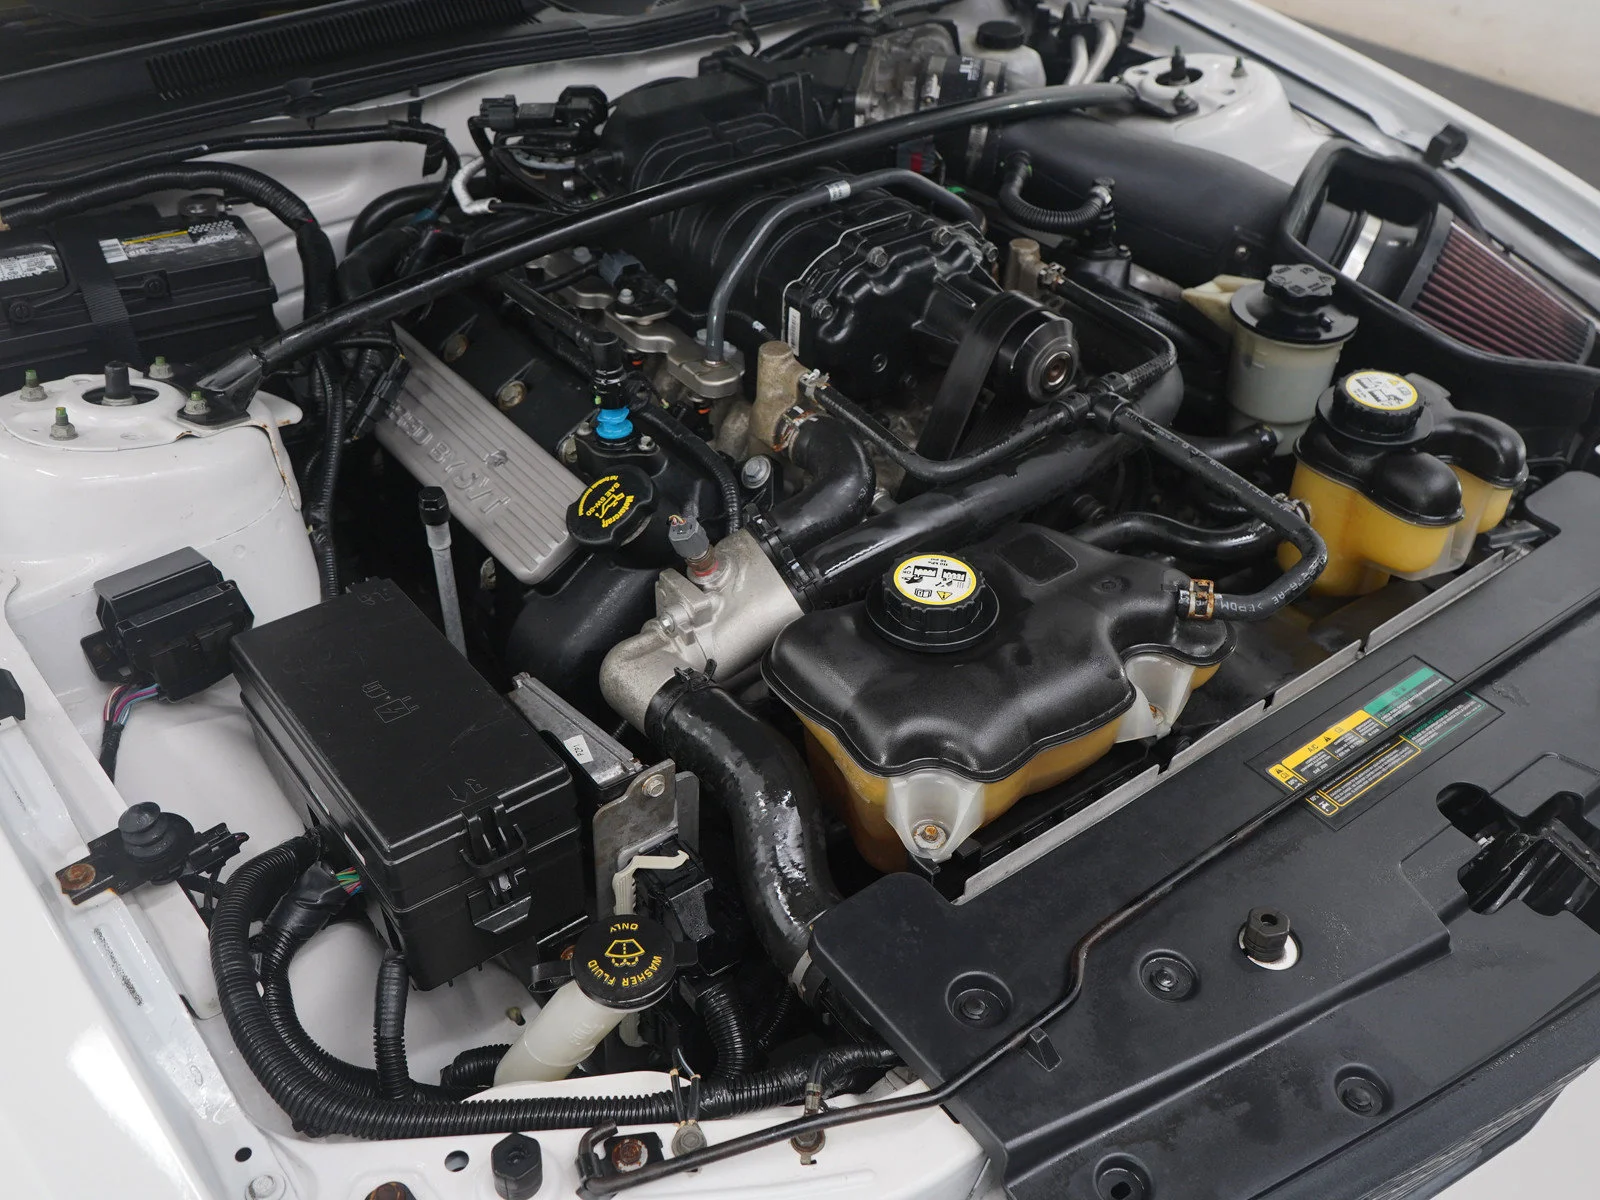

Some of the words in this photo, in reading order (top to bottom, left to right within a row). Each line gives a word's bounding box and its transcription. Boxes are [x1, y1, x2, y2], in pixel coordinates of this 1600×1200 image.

[604, 482, 621, 498] SAE
[585, 496, 607, 517] 5W-50
[602, 495, 635, 528] Motorcraft
[1307, 743, 1319, 753] A/C
[610, 922, 639, 933] ONLY
[587, 959, 616, 987] FLUID
[622, 955, 663, 988] WASHER
